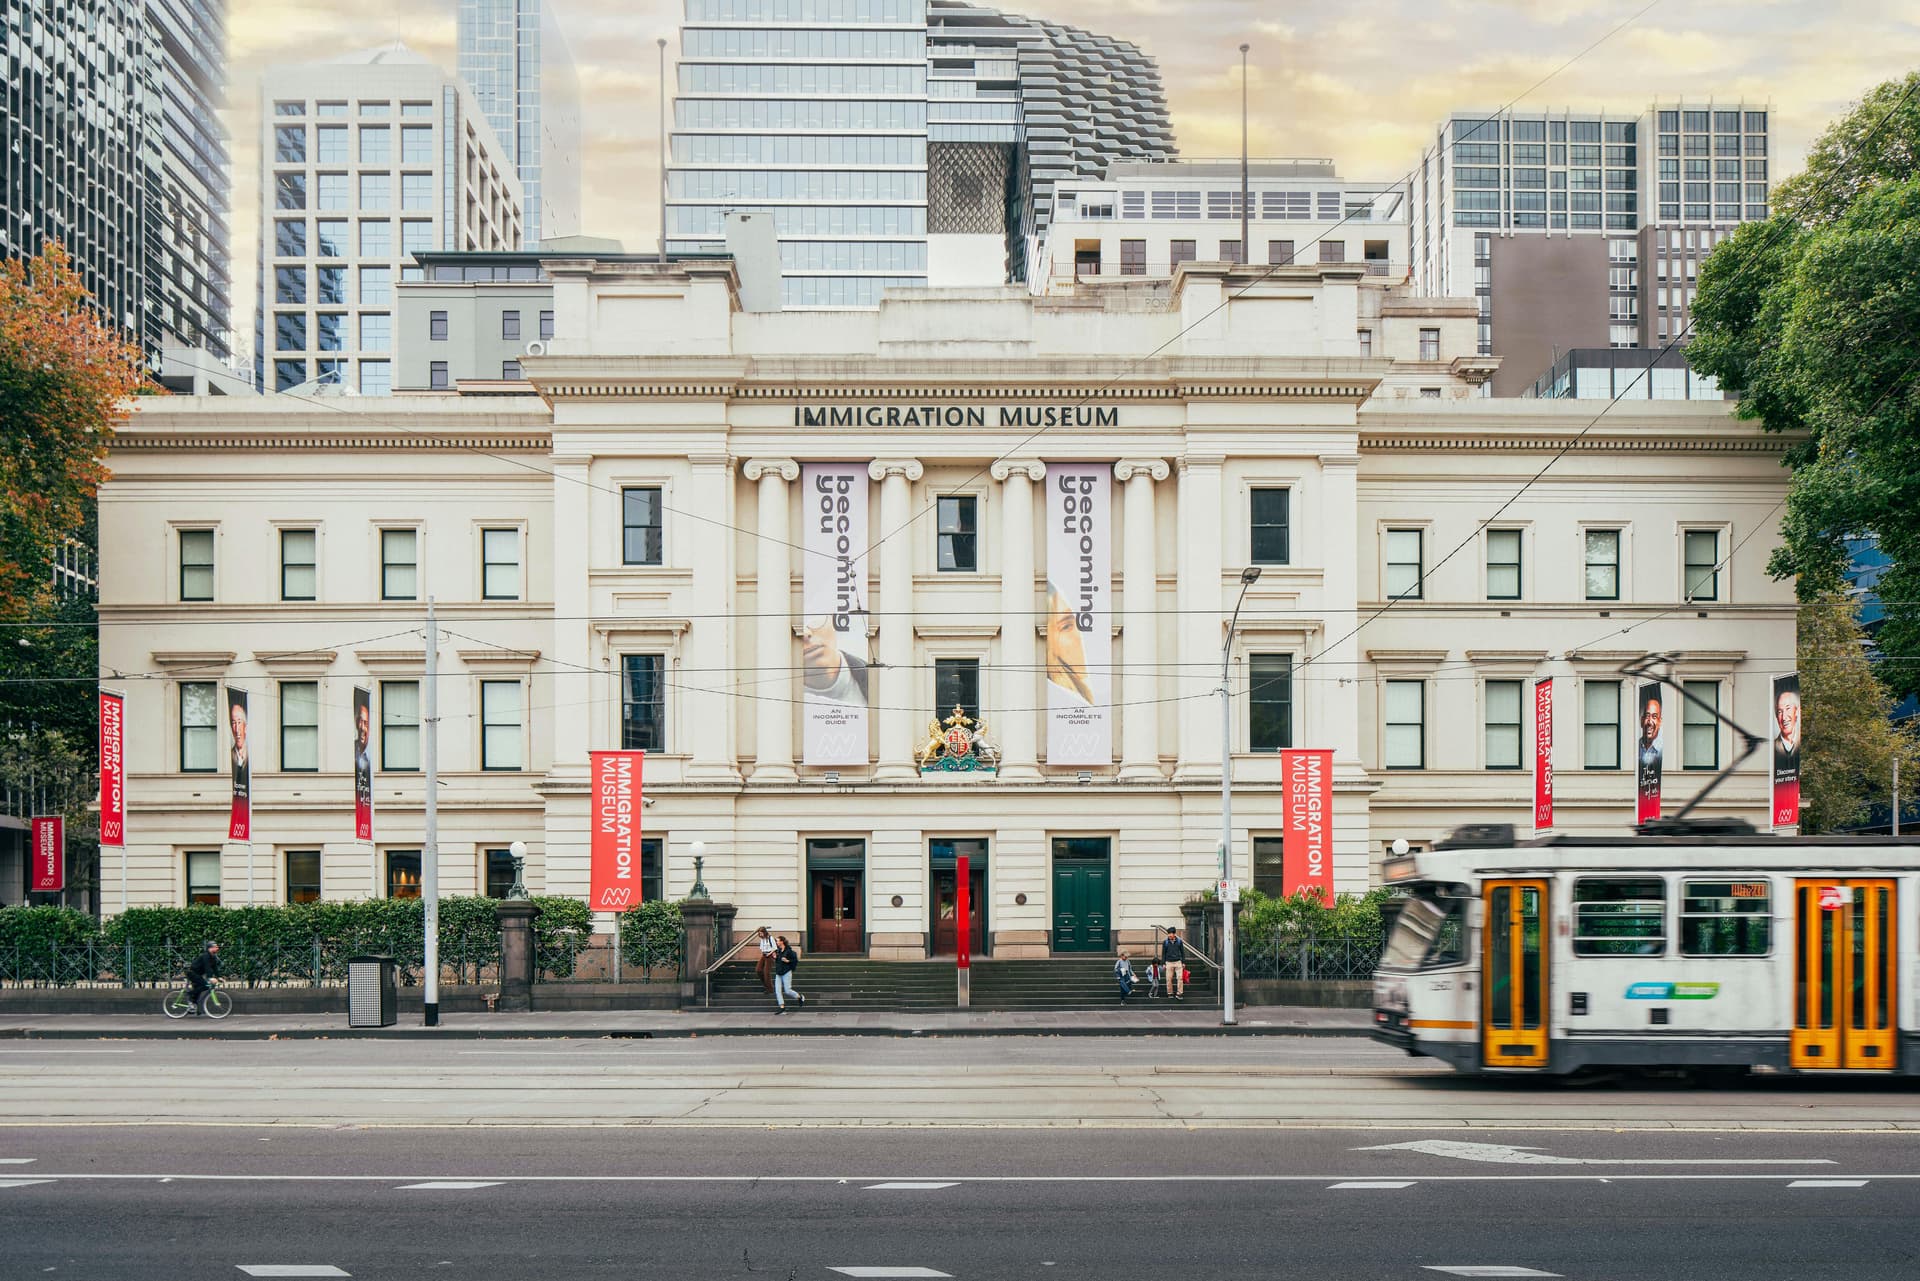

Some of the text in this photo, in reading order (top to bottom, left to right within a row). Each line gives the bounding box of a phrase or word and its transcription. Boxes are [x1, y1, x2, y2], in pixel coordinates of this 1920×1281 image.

[794, 406, 1118, 427] IMMIGRATION MUSEUM
[816, 474, 834, 533] you
[1058, 474, 1077, 533] you
[833, 475, 856, 632] becoming
[1075, 475, 1099, 632] becoming
[103, 700, 112, 770] MUSEUM
[111, 701, 120, 813] IMMIGRATION
[1544, 684, 1552, 796] IMMIGRATION
[601, 757, 617, 833] MUSEUM
[616, 757, 632, 879] IMMIGRATION
[1292, 755, 1307, 831] MUSEUM
[1307, 755, 1323, 877] IMMIGRATION
[47, 821, 55, 876] IMMIGRATION
